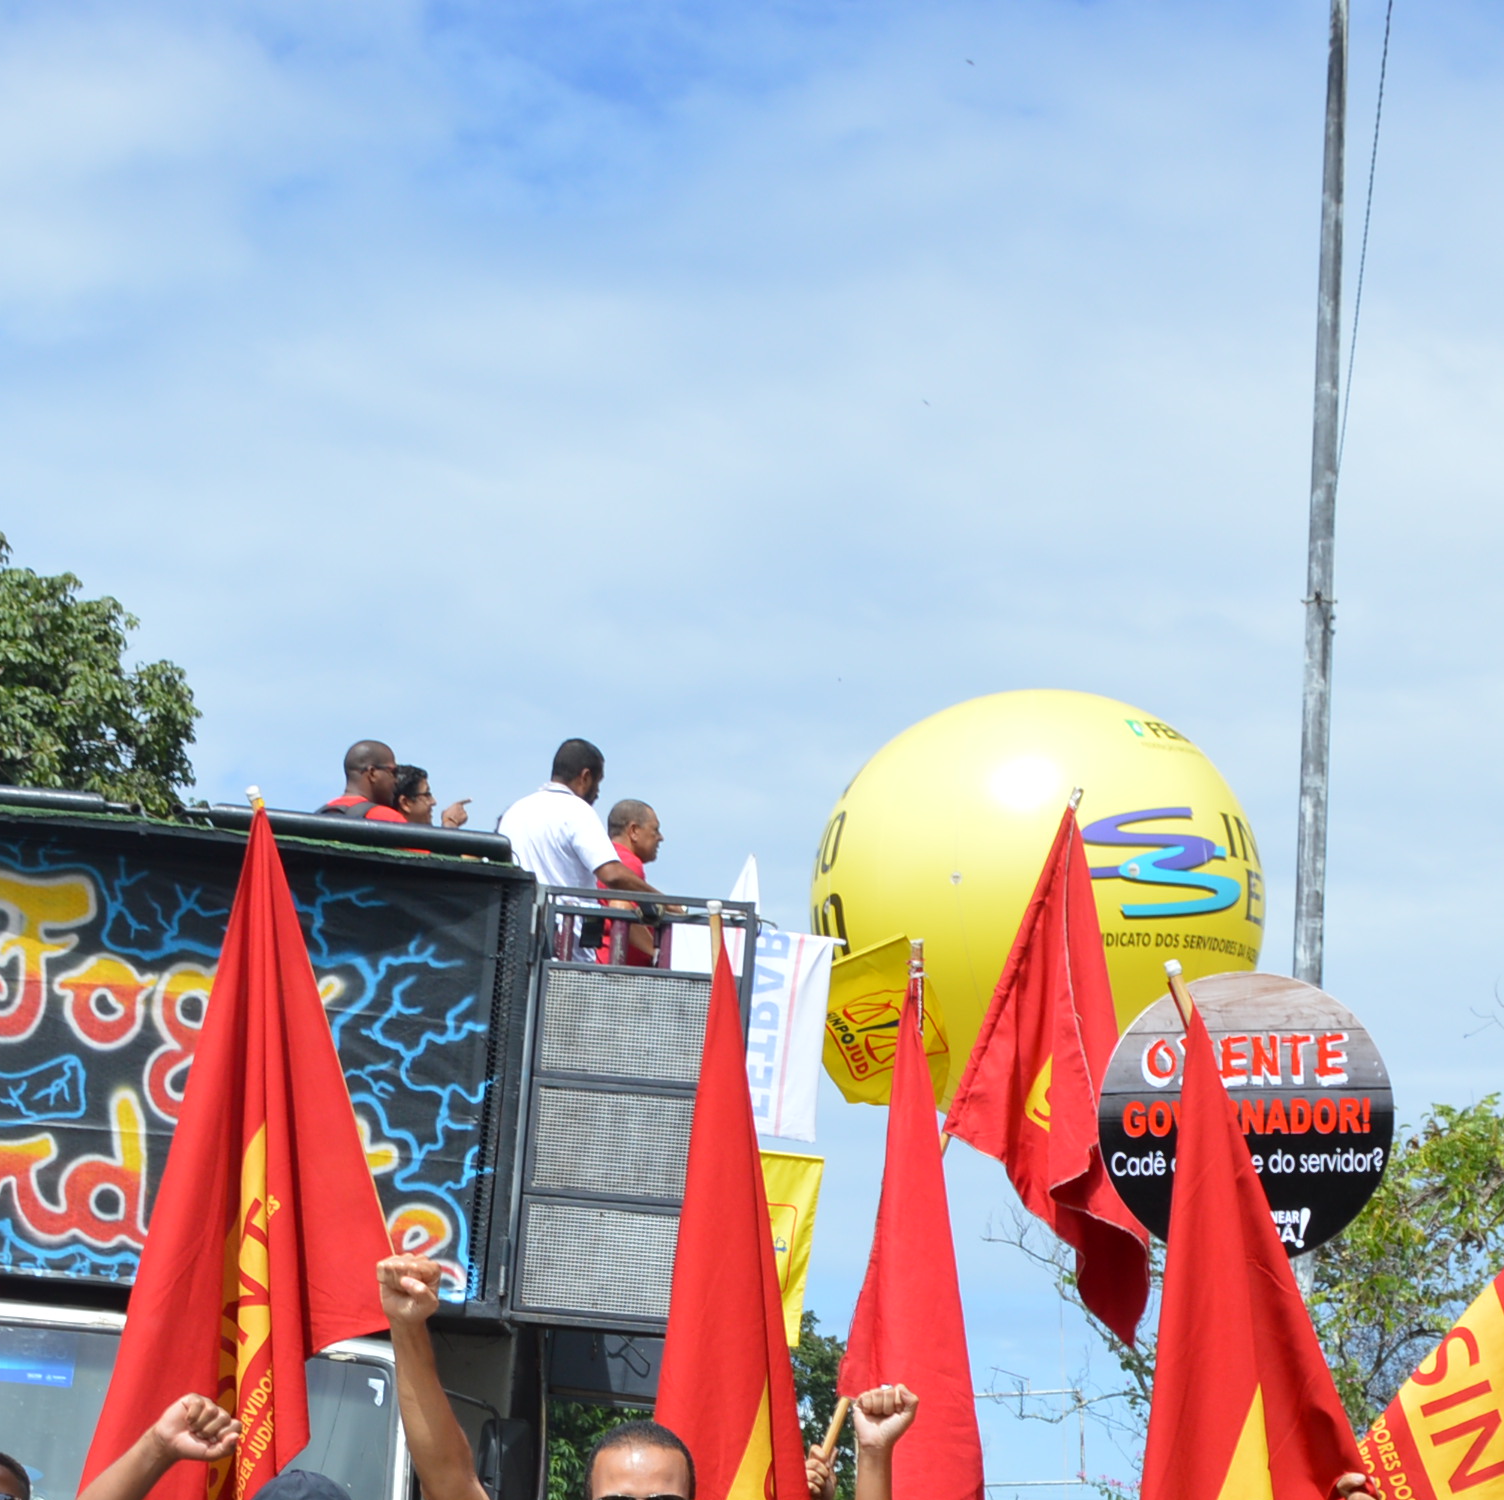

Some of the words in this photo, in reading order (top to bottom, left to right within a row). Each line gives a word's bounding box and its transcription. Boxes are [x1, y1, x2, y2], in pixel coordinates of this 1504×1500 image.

[1101, 931, 1152, 949] DICATO
[1155, 932, 1180, 949] DOS
[1182, 934, 1237, 957] SERVIDORES
[1141, 1031, 1350, 1088] OENTE
[1122, 1096, 1372, 1138] GONADOR!
[1110, 1150, 1167, 1177] Cadê
[1268, 1148, 1296, 1174] do
[1299, 1146, 1384, 1174] servidor?
